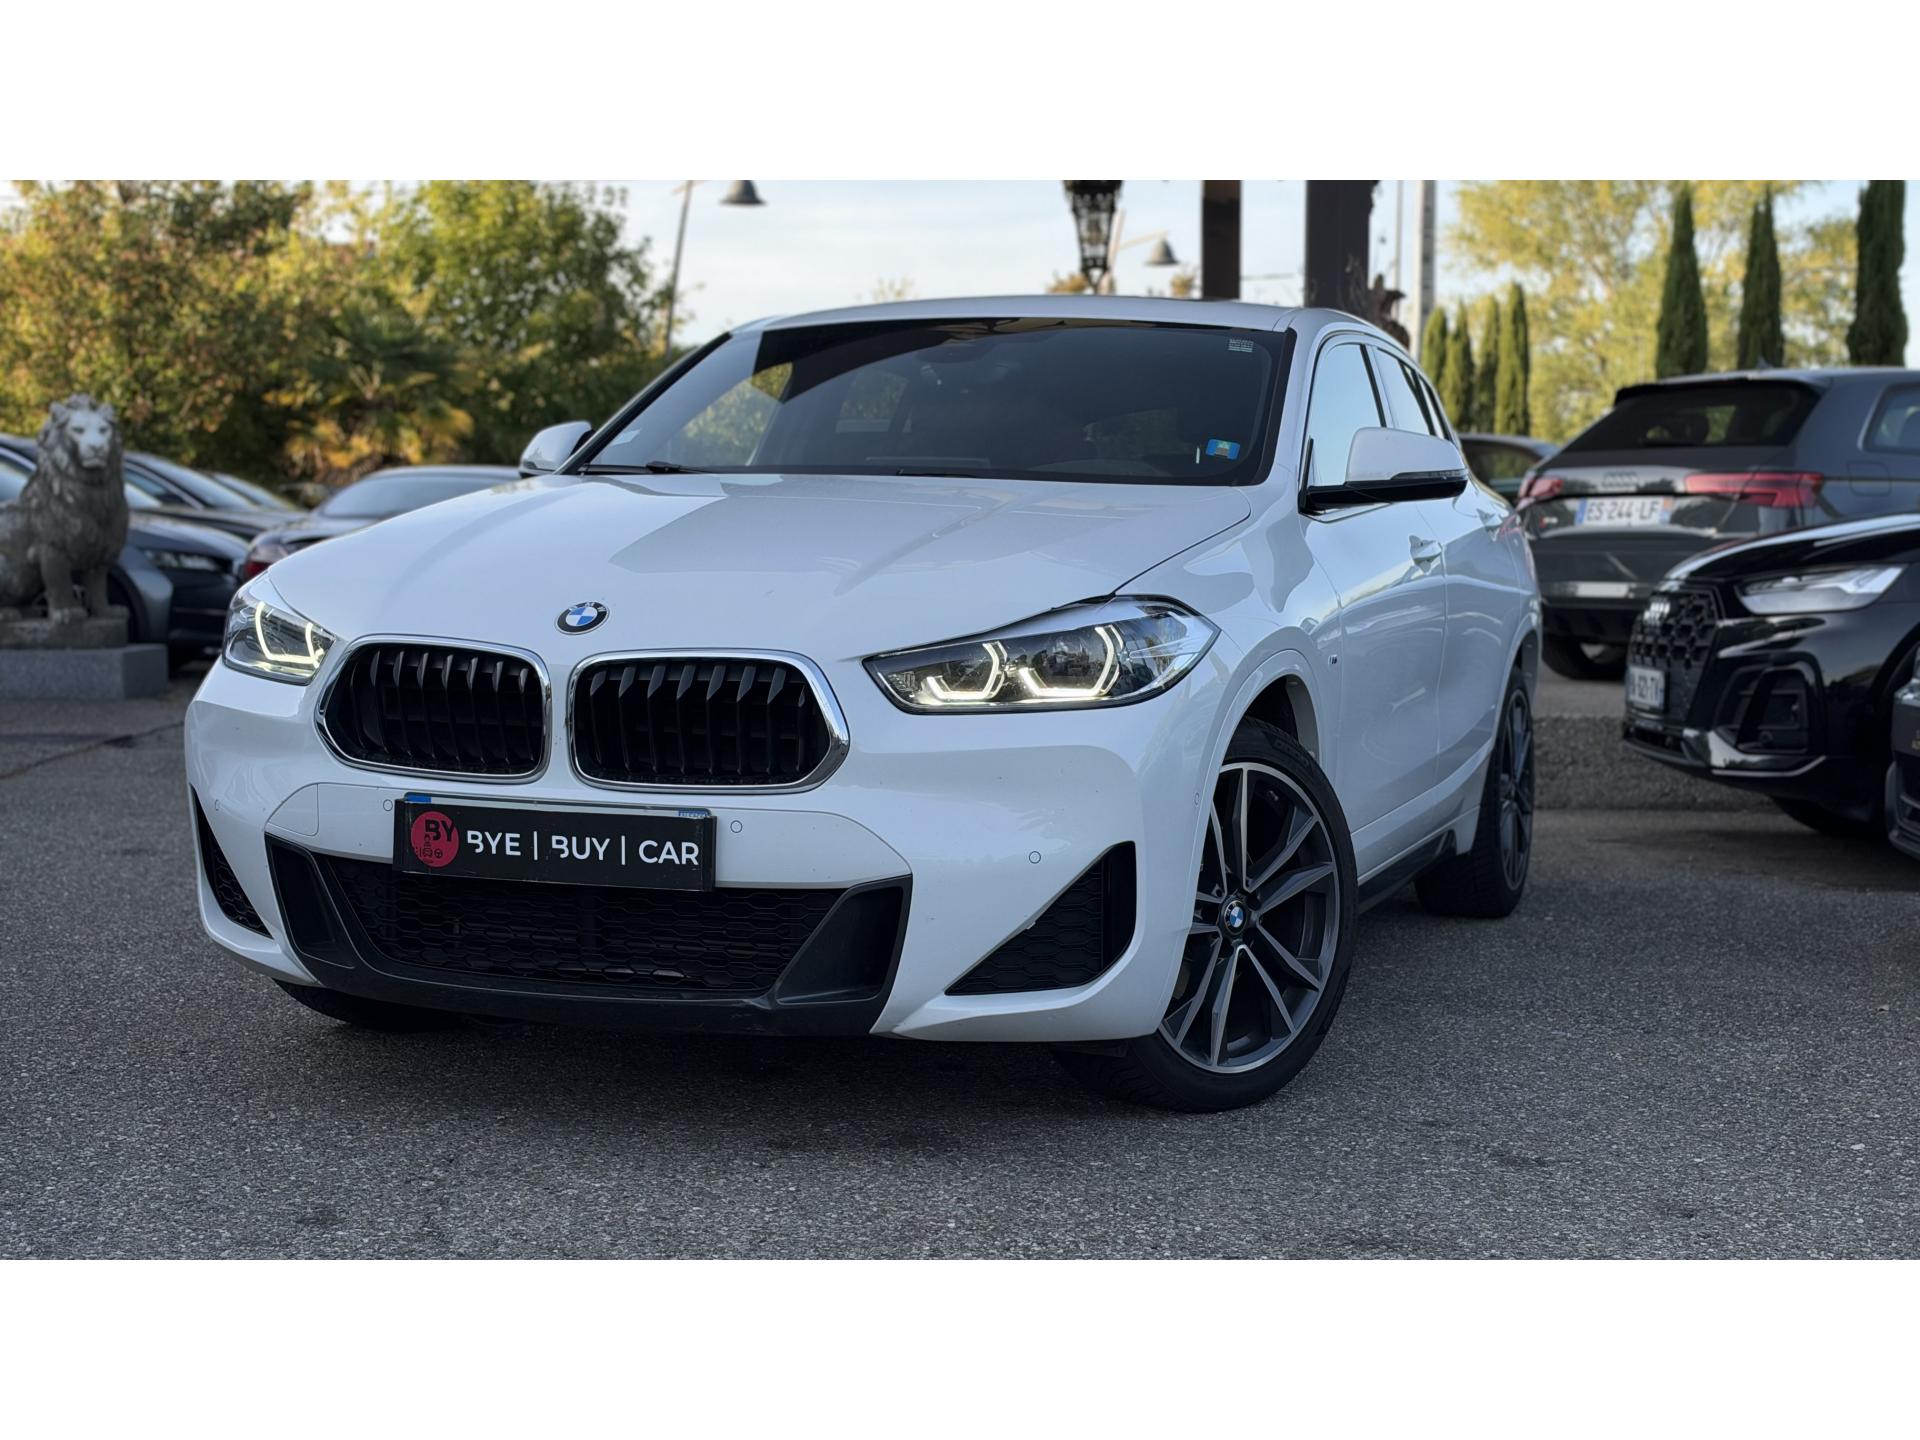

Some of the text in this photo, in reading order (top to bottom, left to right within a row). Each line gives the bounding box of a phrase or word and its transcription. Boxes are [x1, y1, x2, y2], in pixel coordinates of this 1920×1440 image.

[467, 829, 700, 866] BYE BUY CAR
